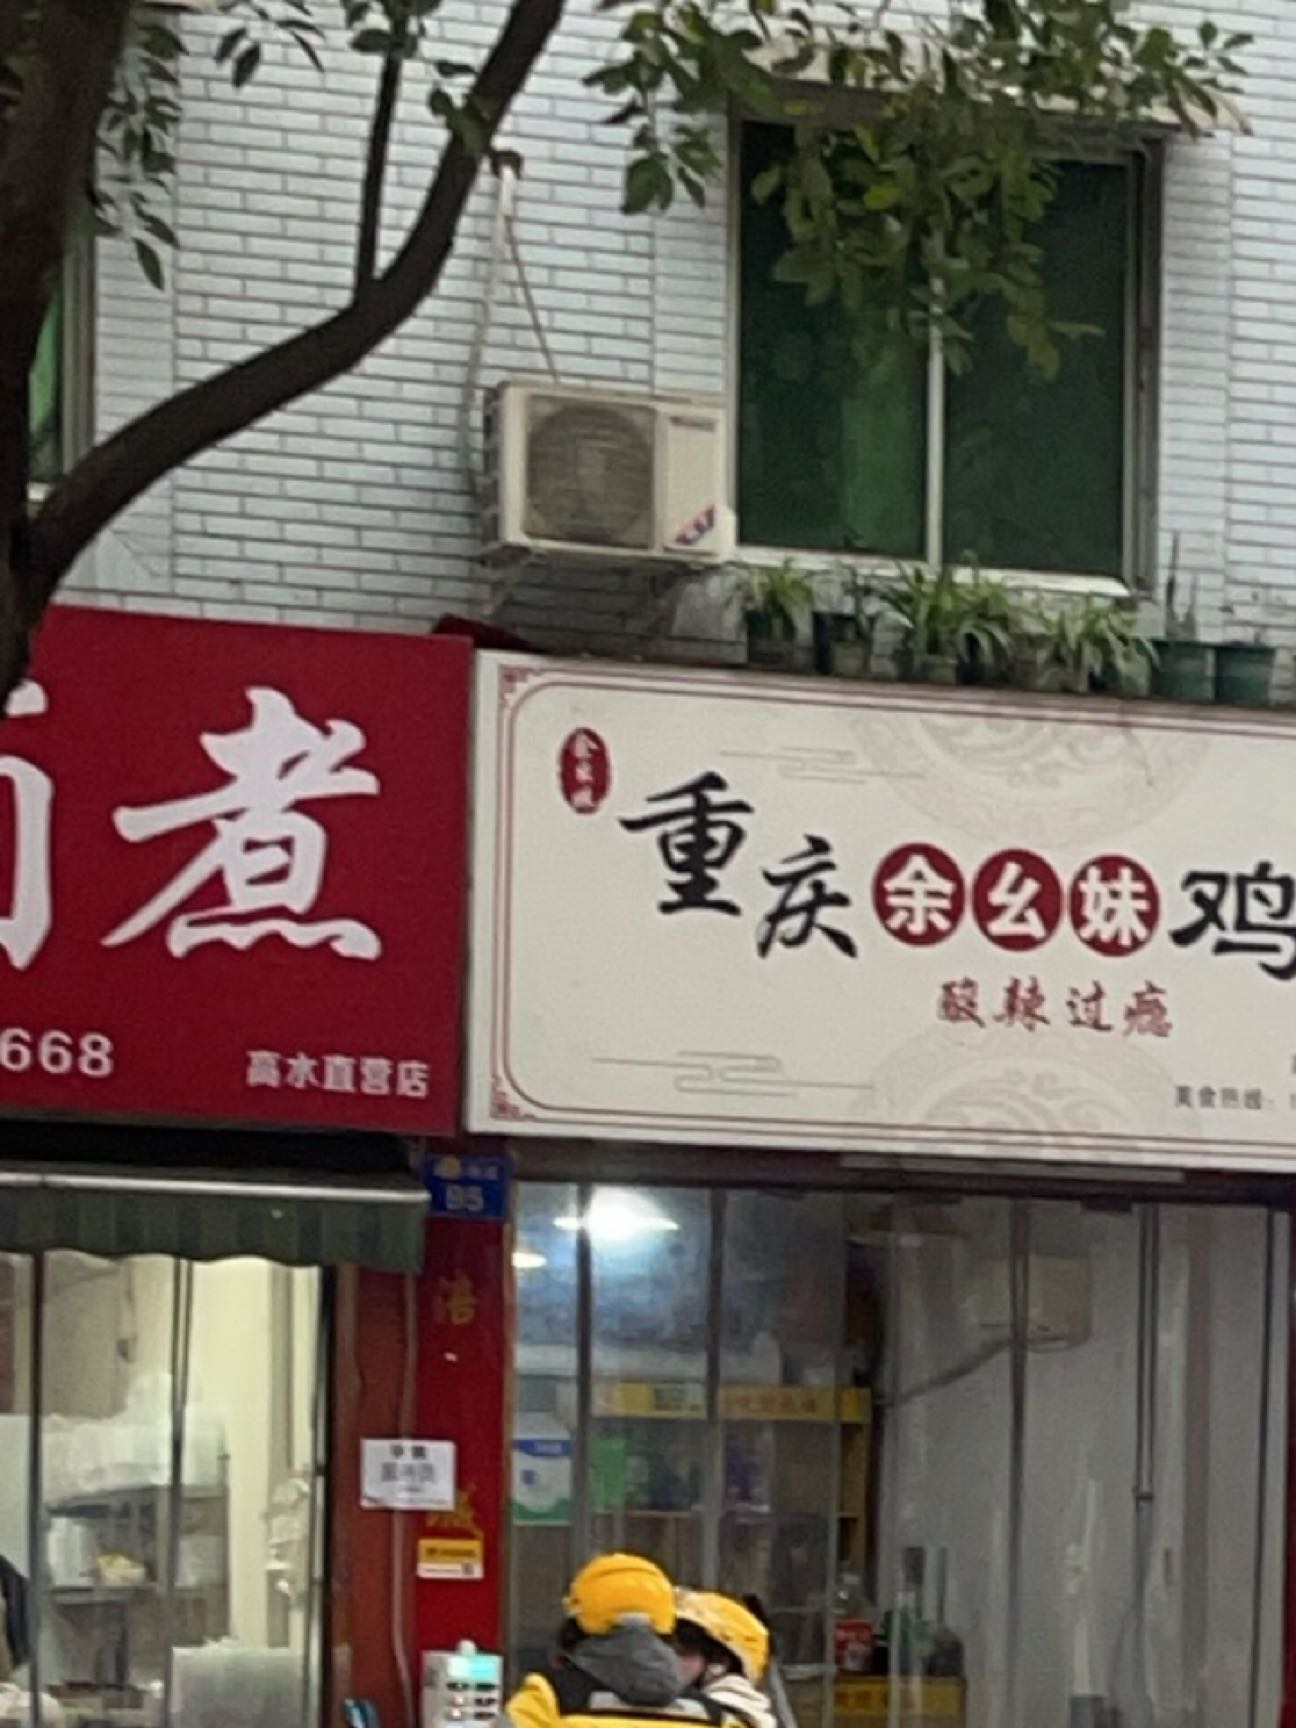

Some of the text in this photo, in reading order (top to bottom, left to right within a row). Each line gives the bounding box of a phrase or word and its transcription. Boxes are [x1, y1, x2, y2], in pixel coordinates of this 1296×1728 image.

[936, 975, 1174, 1039] 酸辣过瘾
[246, 1048, 431, 1099] 高水直营店
